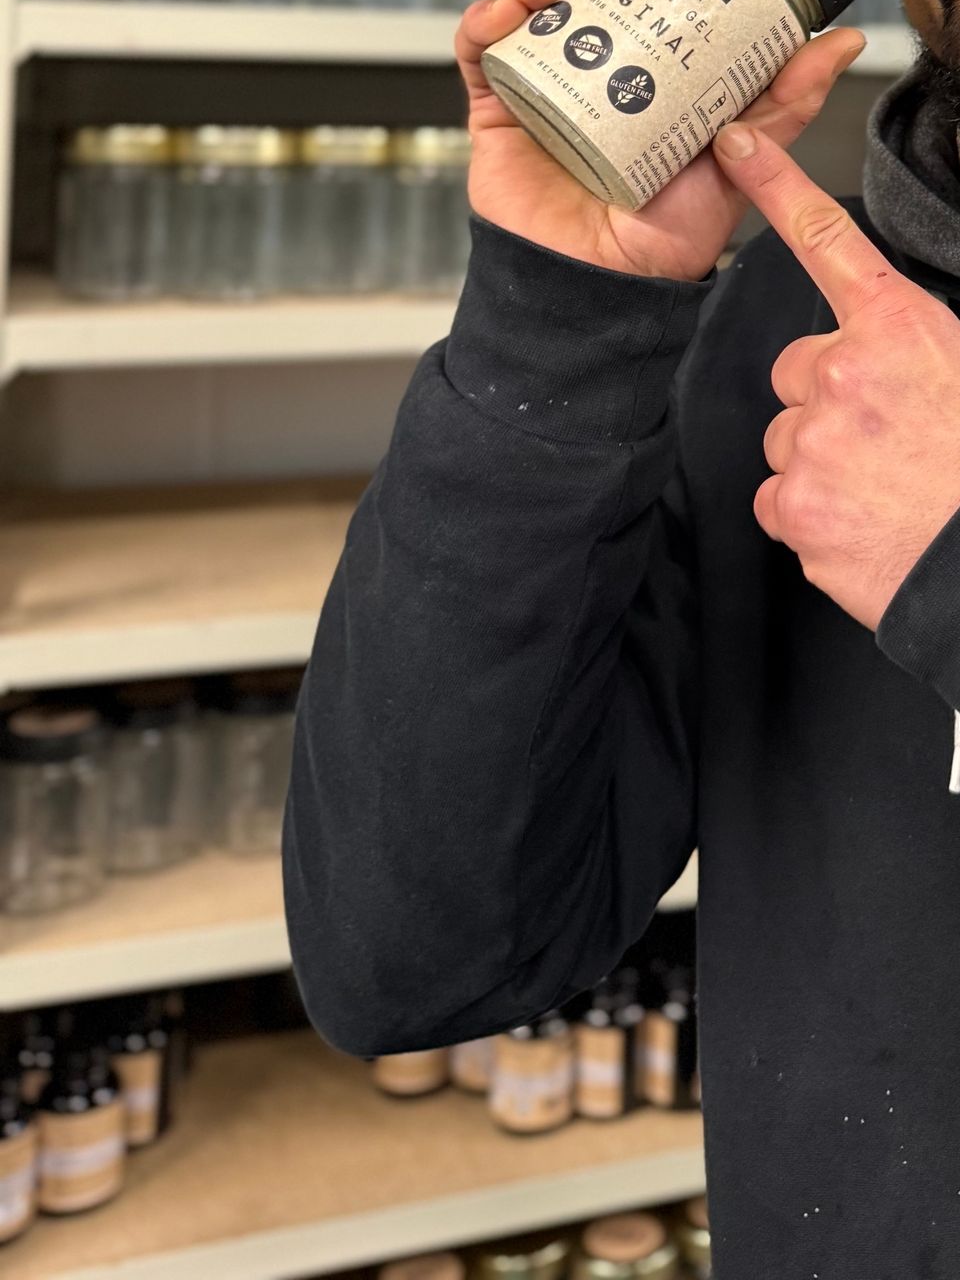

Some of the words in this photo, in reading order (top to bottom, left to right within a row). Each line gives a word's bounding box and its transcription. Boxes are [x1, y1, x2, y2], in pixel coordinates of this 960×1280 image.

[685, 10, 714, 43] GEL
[569, 39, 591, 52] SUGAR
[591, 45, 608, 56] FREE
[517, 45, 535, 59] KEEP
[537, 60, 601, 120] REFRIGERATED
[610, 78, 636, 94] GLUTEN
[635, 88, 653, 100] FREE
